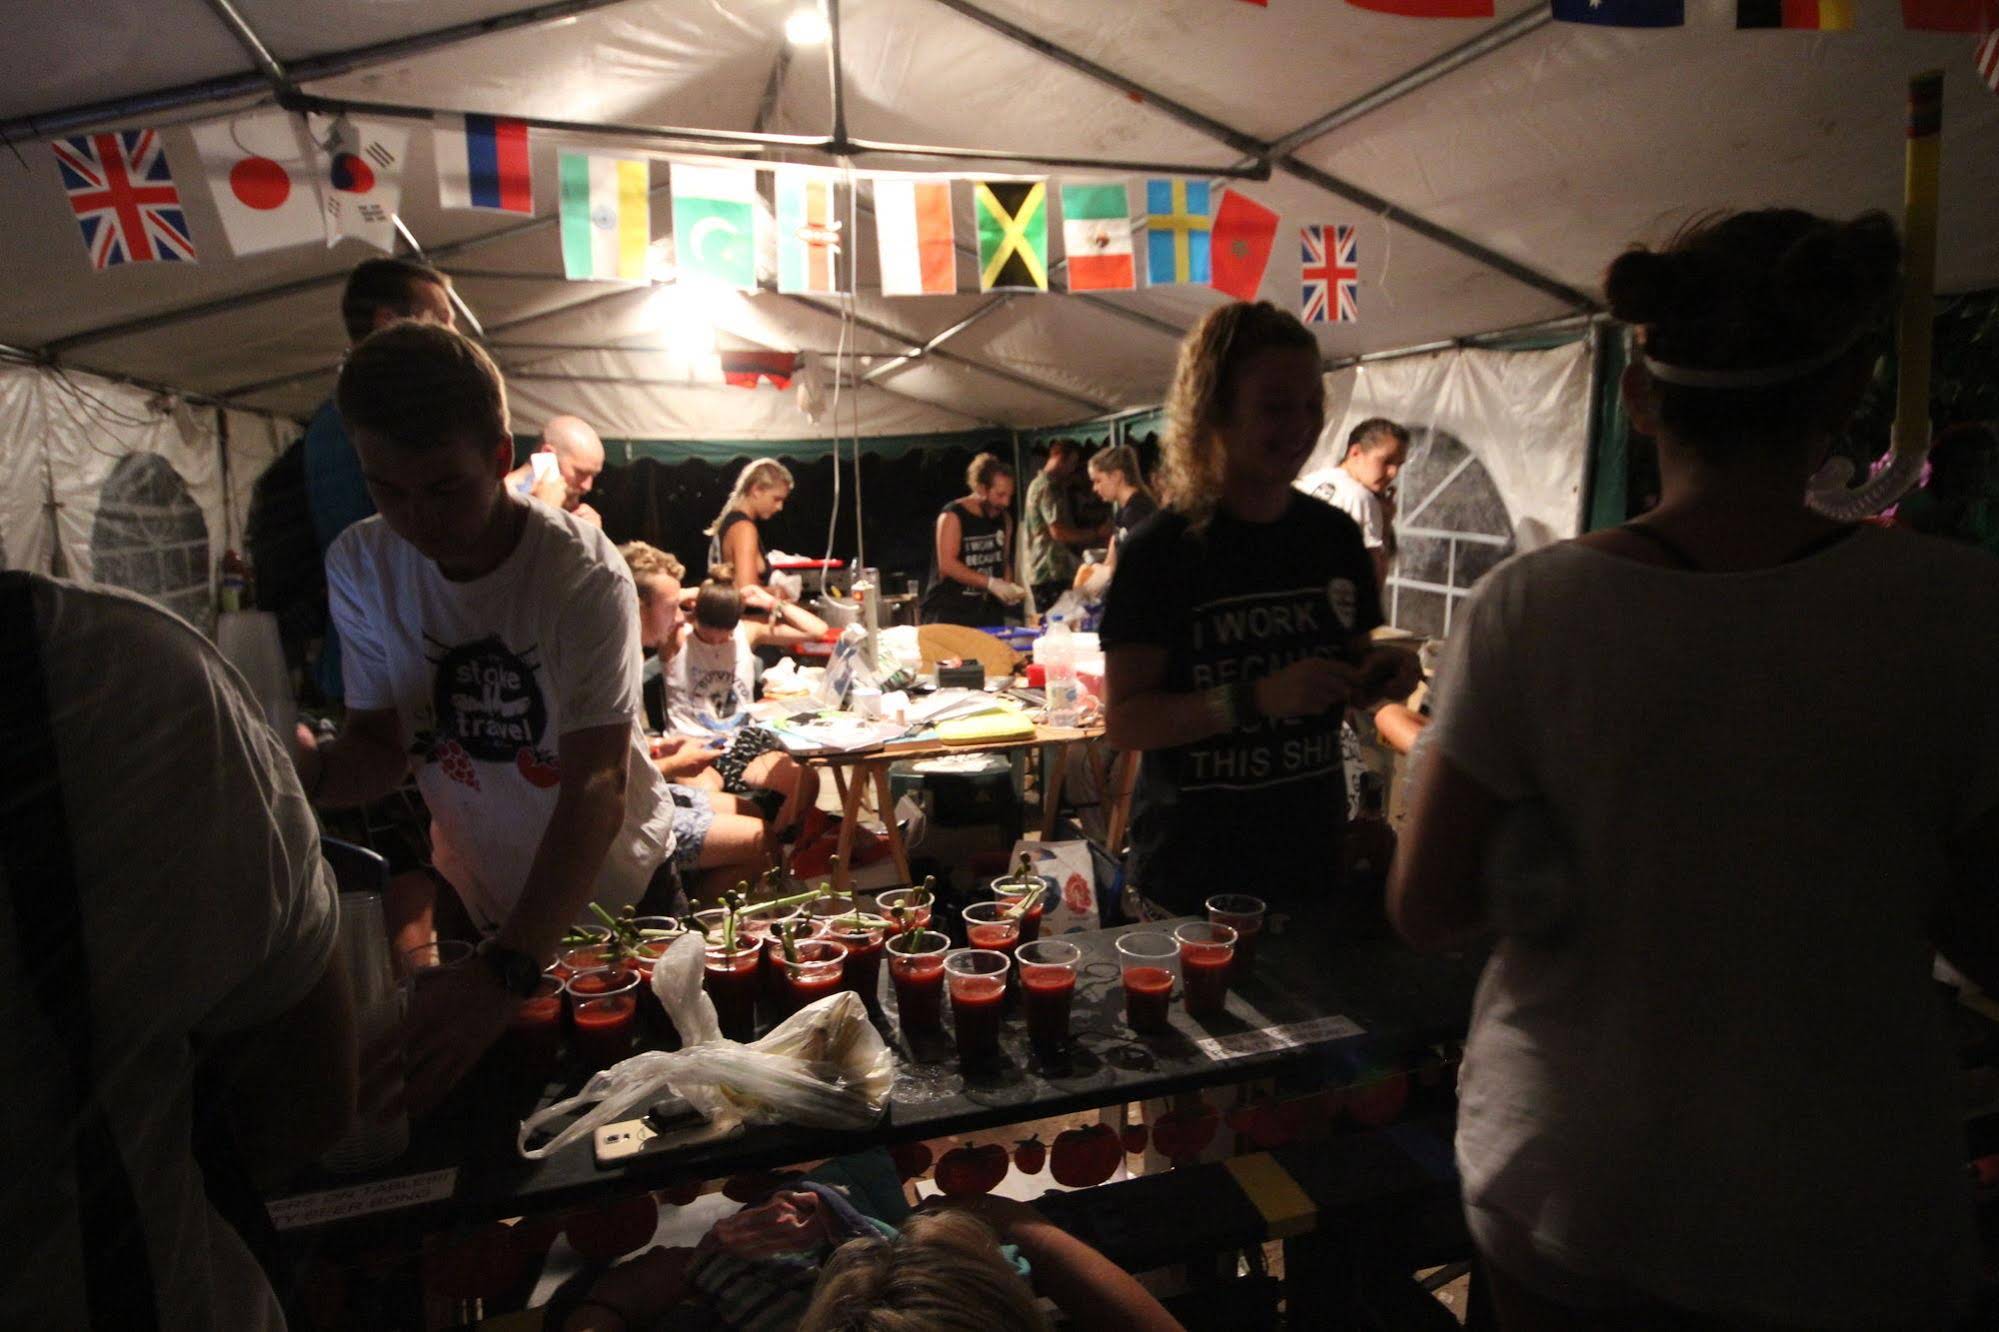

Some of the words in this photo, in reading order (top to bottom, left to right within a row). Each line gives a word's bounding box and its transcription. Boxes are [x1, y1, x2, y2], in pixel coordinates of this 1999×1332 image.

[1193, 620, 1203, 650] I
[1213, 602, 1319, 644] WORK
[456, 711, 532, 741] travel
[1190, 746, 1271, 778] THIS
